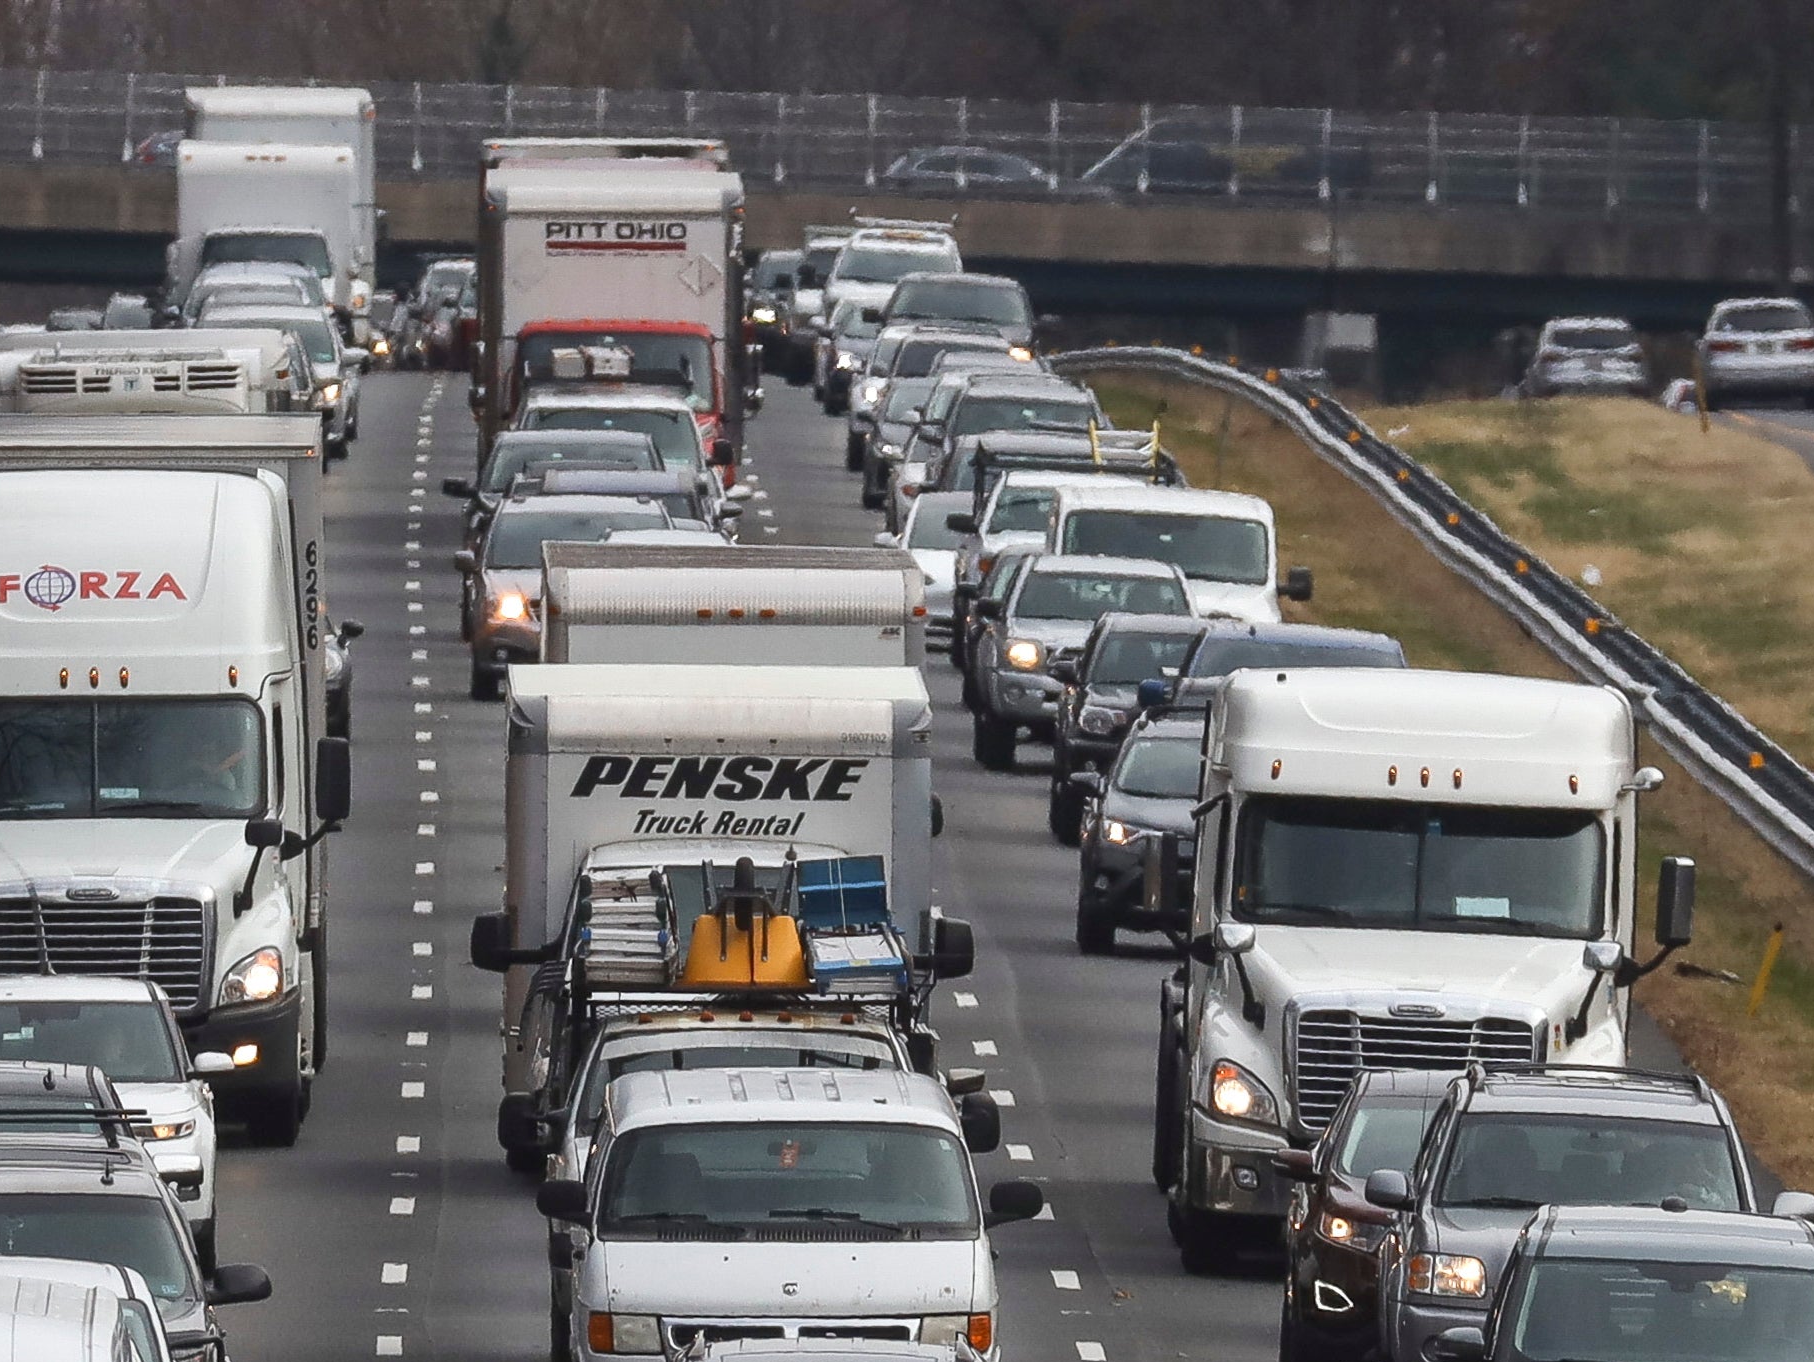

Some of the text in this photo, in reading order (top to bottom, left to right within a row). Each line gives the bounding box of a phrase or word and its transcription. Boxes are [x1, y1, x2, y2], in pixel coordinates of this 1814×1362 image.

[546, 222, 686, 240] PITT OHIO
[305, 540, 318, 651] 6296
[570, 756, 869, 801] PENSKE
[633, 809, 805, 836] Truck Rental
